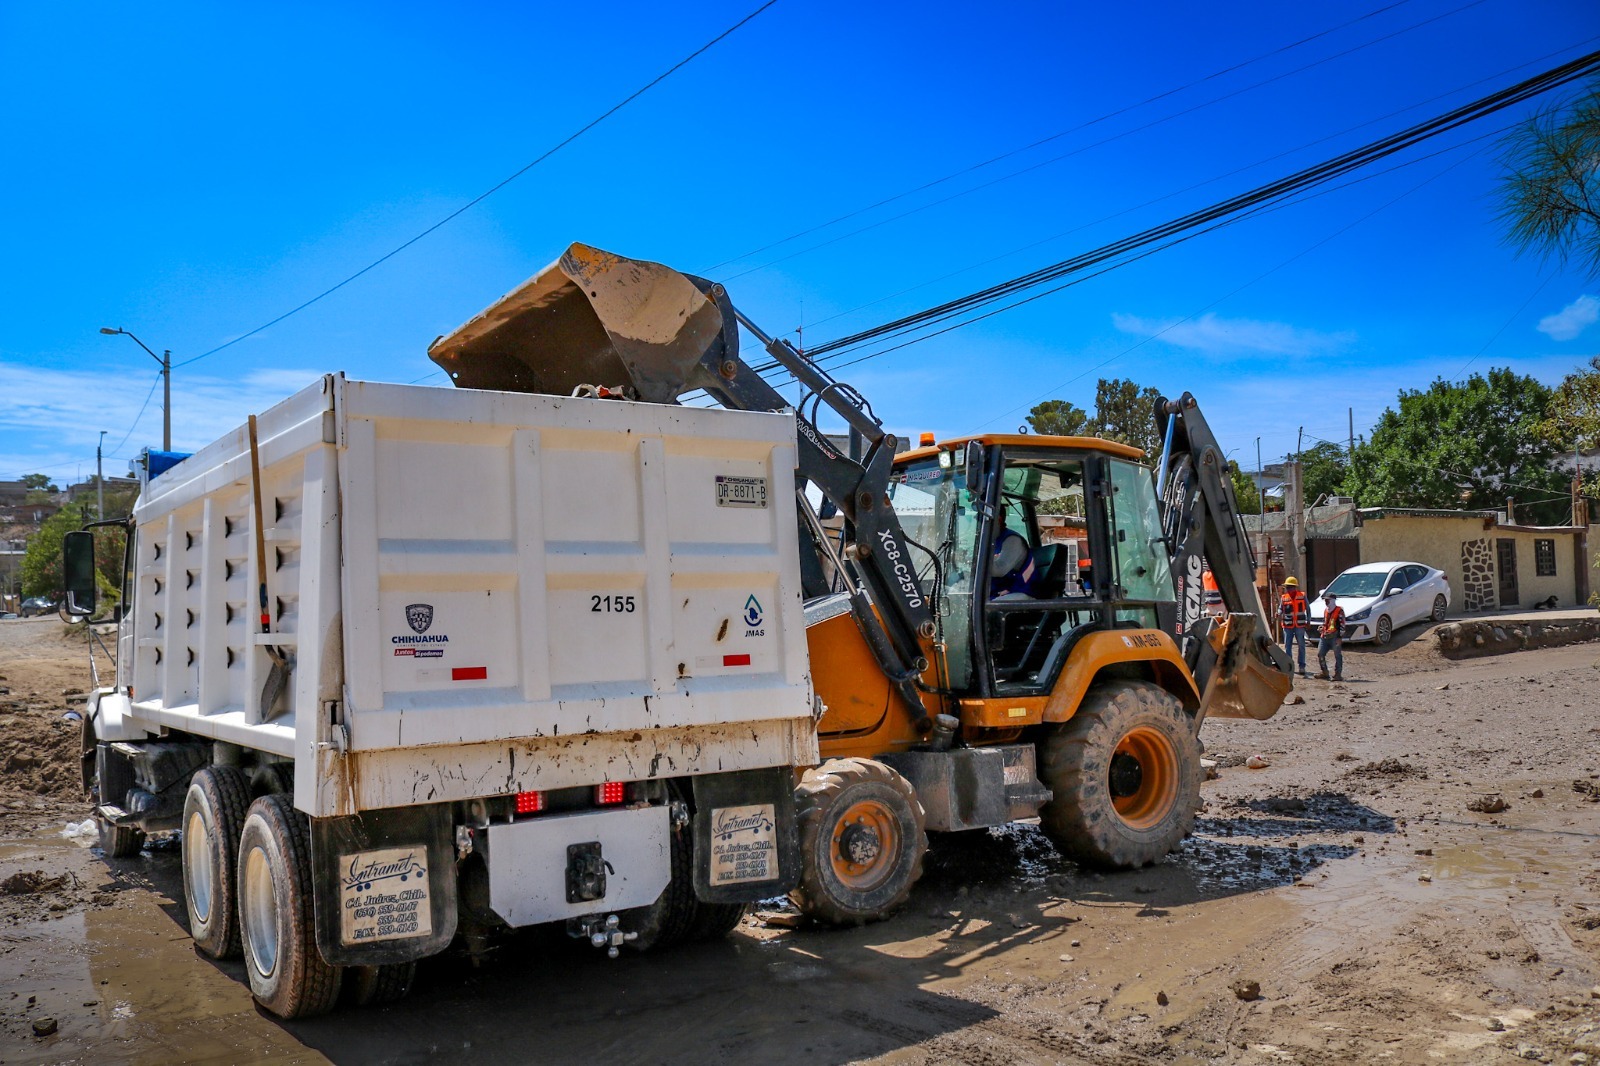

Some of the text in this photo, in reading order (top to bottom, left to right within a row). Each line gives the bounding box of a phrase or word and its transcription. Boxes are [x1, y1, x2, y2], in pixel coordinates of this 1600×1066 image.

[718, 484, 766, 499] DR-8871-B
[877, 529, 922, 608] XC8-C2570
[591, 595, 635, 613] 2155
[391, 635, 449, 644] CHIHUAHUA
[745, 629, 765, 637] JMAS
[713, 809, 766, 834] Intramet
[342, 853, 417, 884] Intramet
[346, 897, 362, 909] Cd.
[400, 889, 426, 901] Chih.
